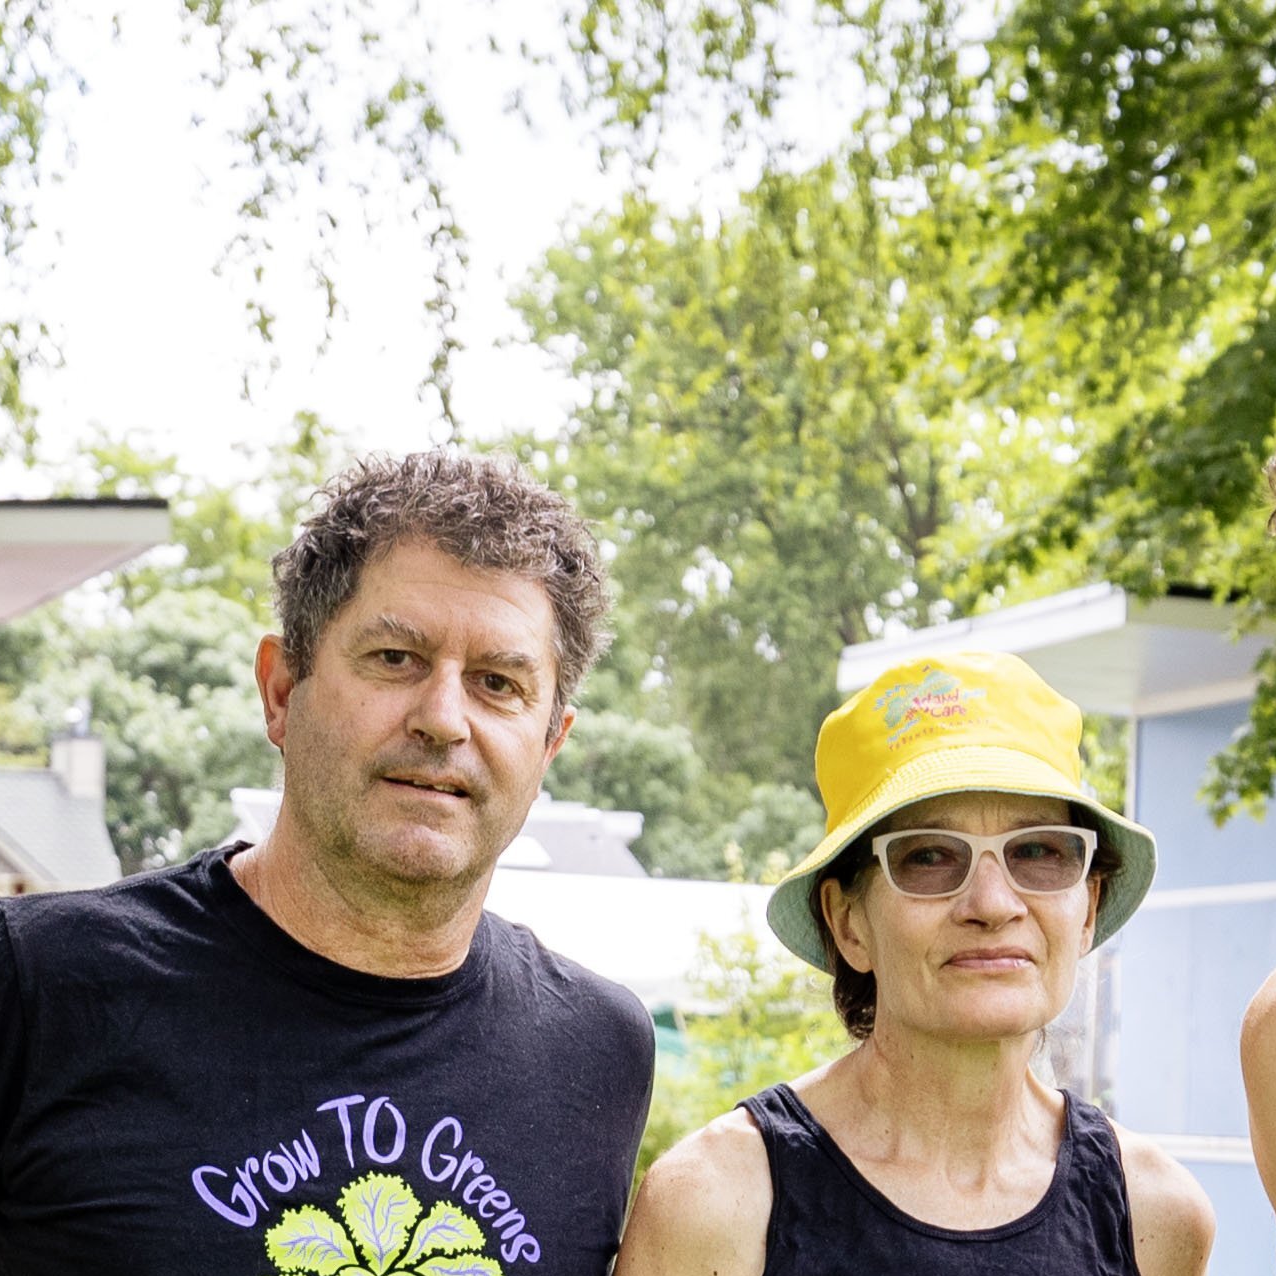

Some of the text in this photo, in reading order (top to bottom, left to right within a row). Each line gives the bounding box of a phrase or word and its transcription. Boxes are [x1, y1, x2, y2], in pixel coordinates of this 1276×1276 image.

[191, 1094, 542, 1264] Grow TO Greens
